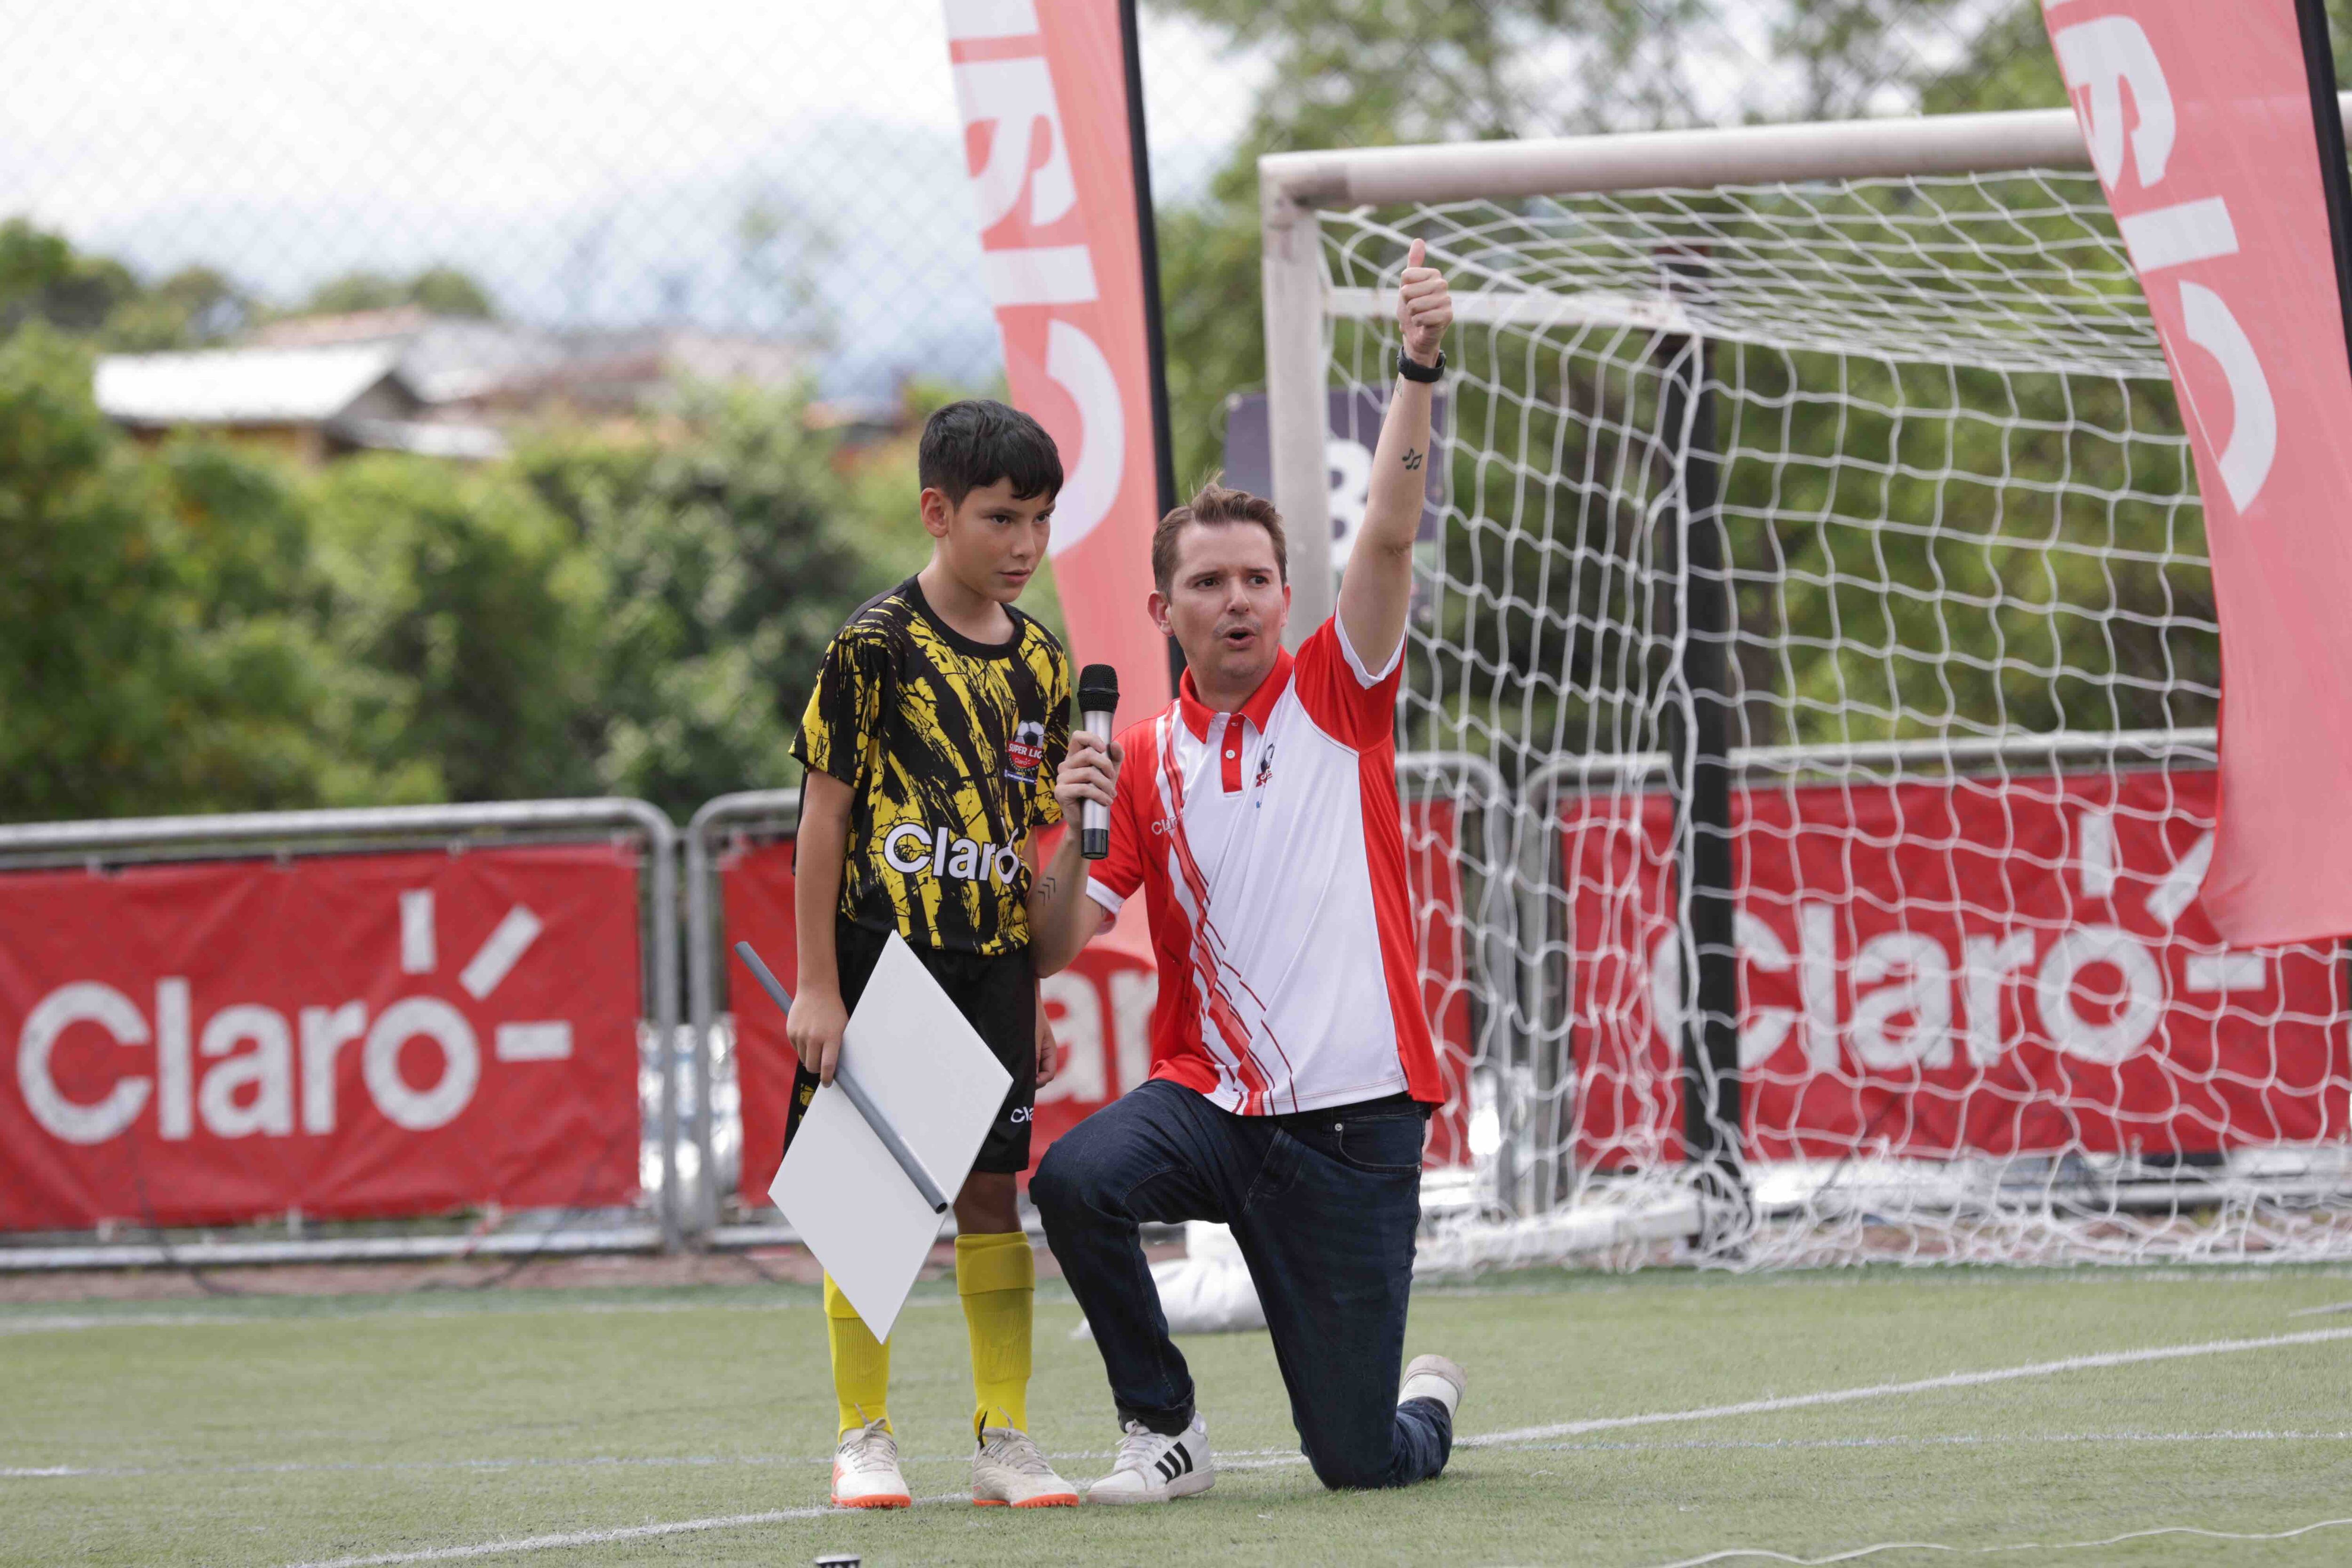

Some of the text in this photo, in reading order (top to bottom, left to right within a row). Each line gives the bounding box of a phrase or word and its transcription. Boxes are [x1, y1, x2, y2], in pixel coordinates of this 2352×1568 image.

[1008, 743, 1027, 756] SUPER
[884, 823, 1020, 884] Claro
[1651, 901, 2163, 1072] Claro
[16, 975, 481, 1144] Claro
